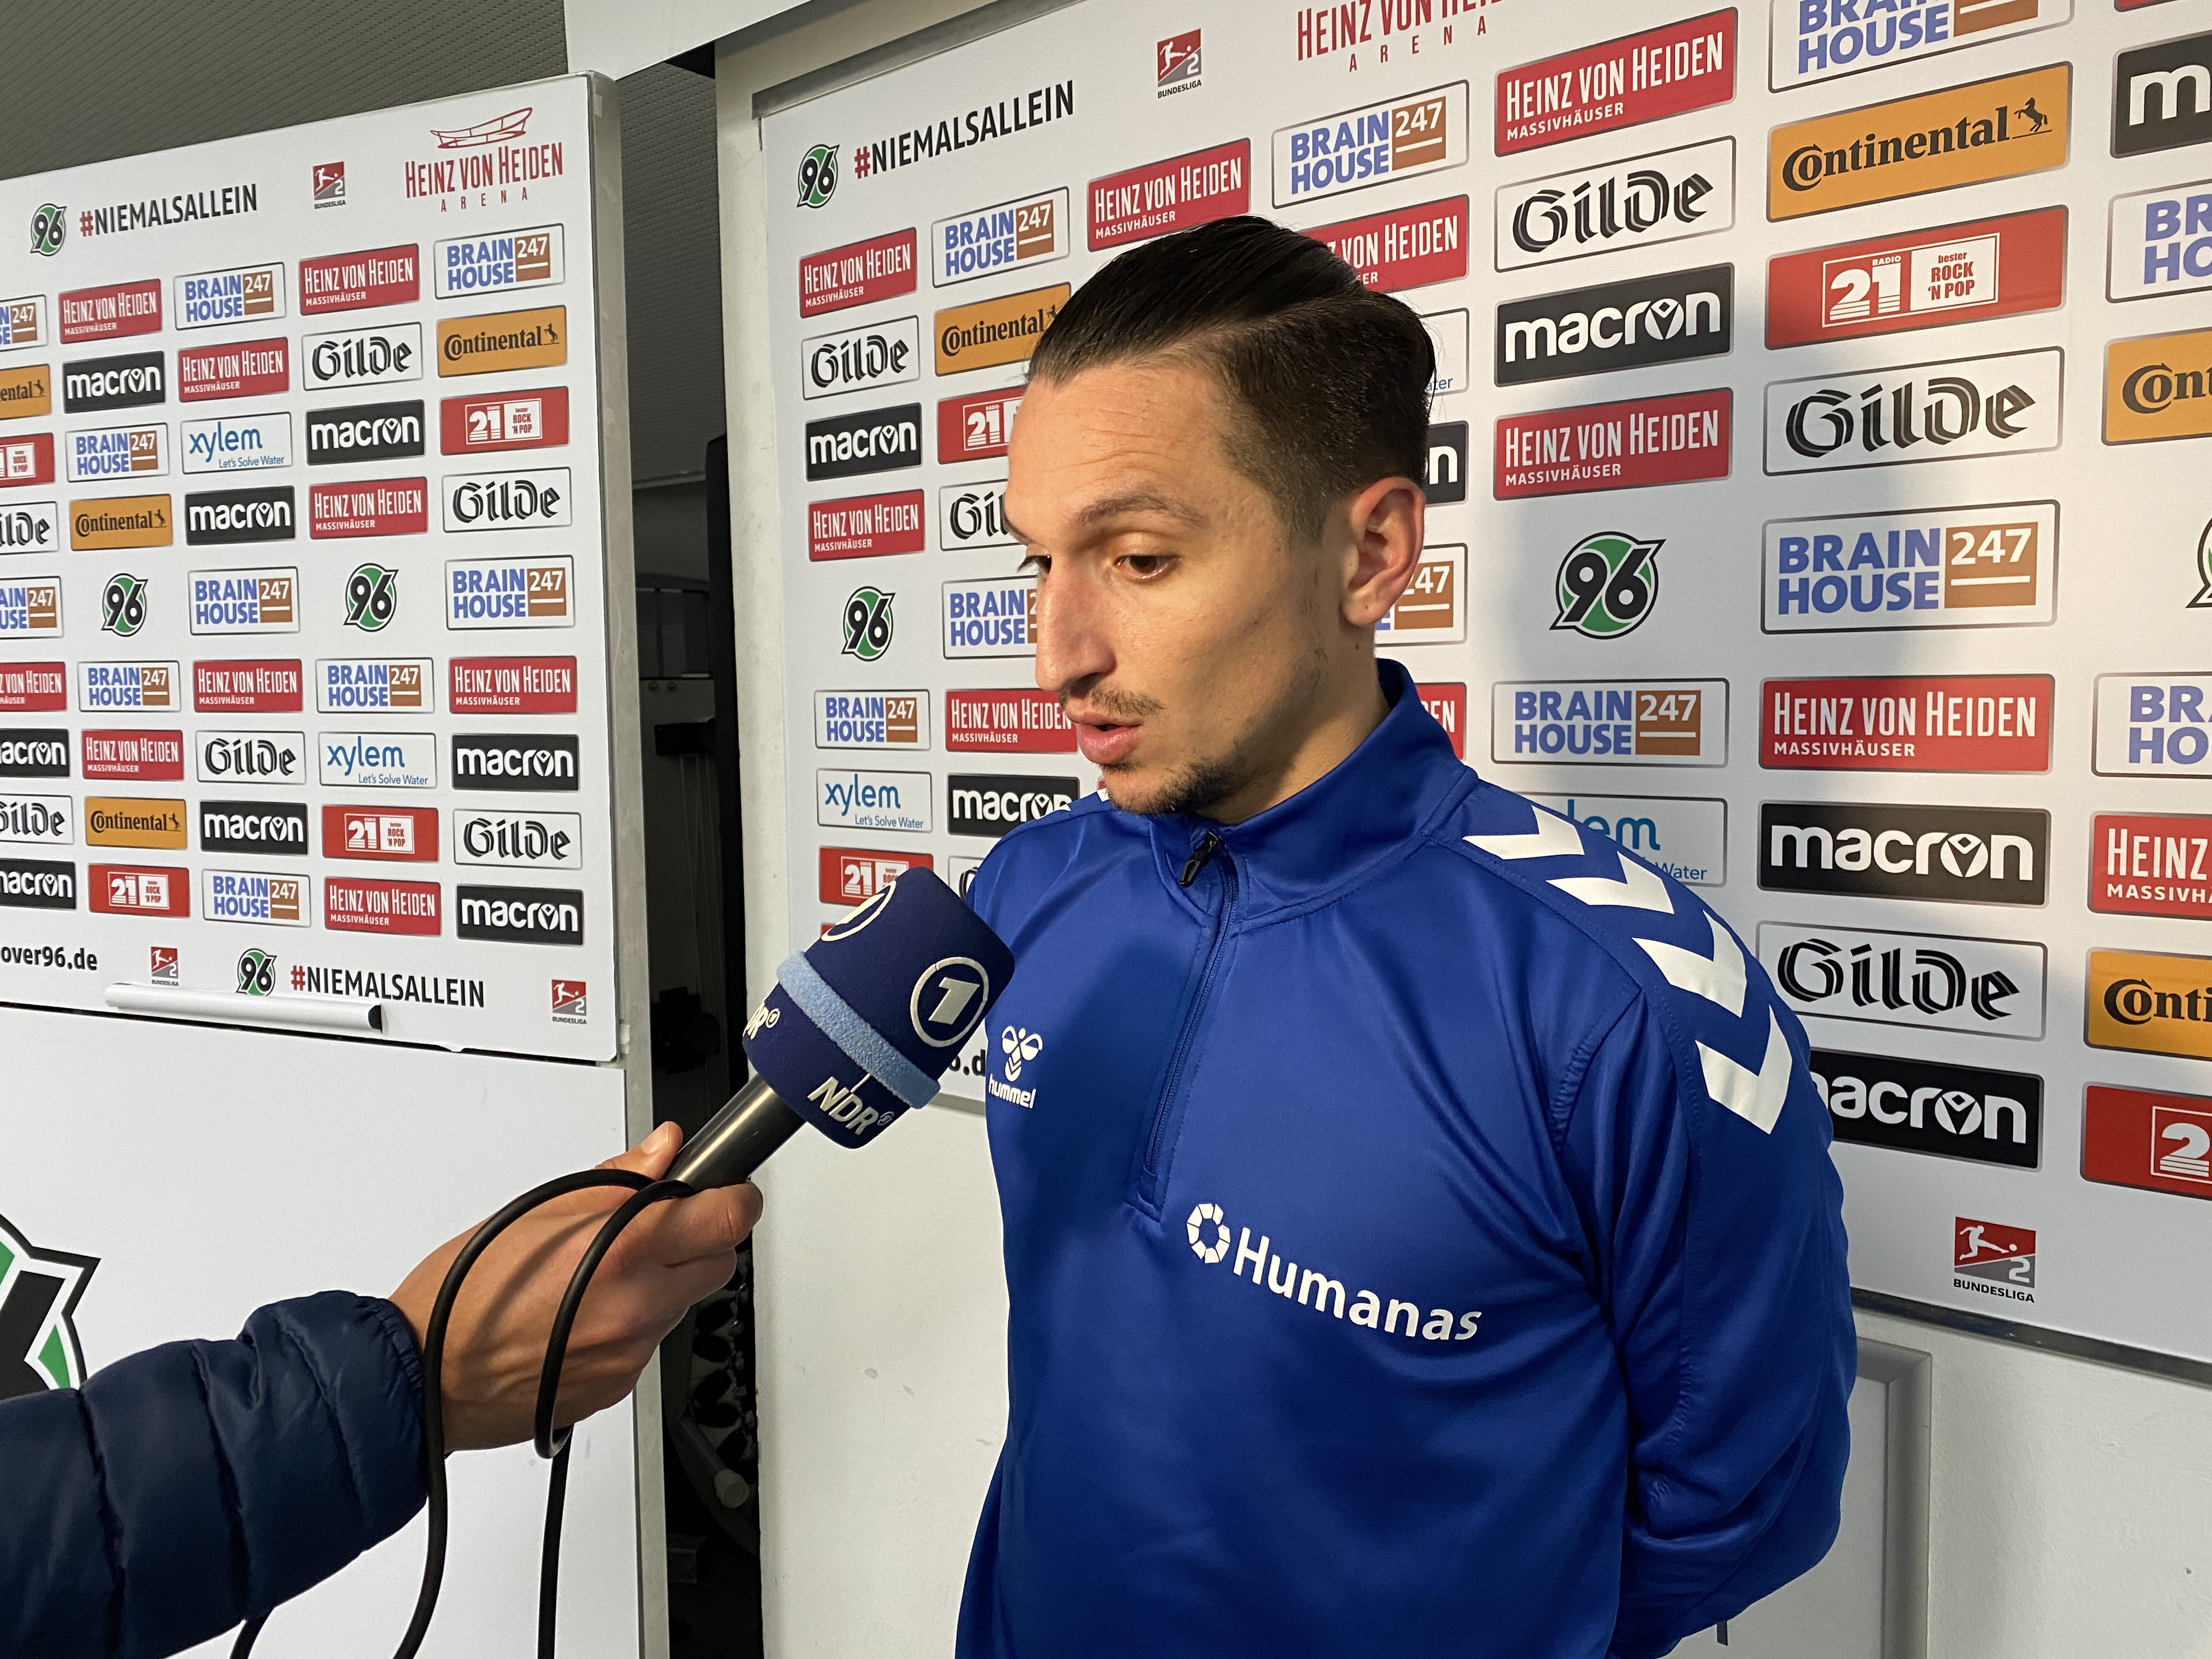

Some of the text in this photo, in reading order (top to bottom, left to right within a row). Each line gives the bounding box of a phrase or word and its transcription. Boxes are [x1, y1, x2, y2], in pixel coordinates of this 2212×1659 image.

[1298, 0, 1431, 60] HEINZ VON
[1799, 0, 1938, 35] BRA
[1349, 15, 1486, 72] ARENA
[1798, 3, 1949, 74] HOUSE
[1187, 56, 1199, 74] 2
[1158, 80, 1201, 99] BUNDESLIGA
[1507, 102, 1624, 141] MASSIVHÄUSER
[802, 80, 1073, 201] 96 #NIEMALSALLEIN
[1783, 106, 2010, 191] Continental
[405, 143, 563, 198] HEINZ VON HEIDEN
[335, 179, 344, 195] 2
[441, 187, 528, 212] ARENA
[33, 184, 257, 250] 96 #NIEMALSALLEIN
[314, 200, 346, 210] BUNDESLIGA
[1513, 170, 1713, 252] Gilde
[1341, 216, 1457, 268] VON HEIDEN
[1938, 251, 1967, 263] bester
[805, 244, 910, 295] HEINZ VON HEIDEN
[1931, 263, 1973, 283] ROCK
[1830, 264, 1901, 321] 21
[1945, 279, 1975, 298] POP
[13, 306, 34, 324] 247
[63, 292, 156, 325] HEINZ VON HEIDEN
[186, 297, 242, 323] HOUSE
[941, 308, 1043, 357] Continental
[1505, 291, 1720, 363] macron
[312, 336, 412, 381] Gilde
[444, 326, 542, 361] Continental
[183, 350, 283, 382] HEINZ VON HEIDEN
[811, 335, 909, 388] Gilde
[469, 410, 501, 441] 21
[513, 413, 531, 424] ROCK
[519, 424, 532, 433] POP
[967, 409, 1000, 447] 21
[1786, 376, 2036, 458] Gilde
[76, 433, 155, 455] BRAIN 247
[189, 421, 262, 462] xylem
[810, 422, 917, 464] macron
[77, 454, 128, 475] HOUSE
[219, 455, 284, 468] Let's Solve Water
[1505, 464, 1621, 486] MASSIVHÄUSER
[0, 512, 49, 546] lde
[75, 511, 153, 537] Continental
[189, 502, 291, 531] macron
[315, 520, 375, 531] MASSIVHÄUSER
[1779, 528, 2032, 574] BRAIN 247
[195, 579, 290, 602] BRAIN 247
[453, 569, 563, 593] BRAIN 247
[1403, 566, 1450, 595] 47
[1562, 548, 1652, 622] 96
[0, 588, 54, 607] AIN 247
[106, 583, 142, 628] 96
[351, 575, 391, 620] 96
[950, 589, 1024, 619] BRAIN
[0, 610, 26, 629] USE
[847, 599, 889, 650] 96
[5, 673, 25, 693] VON
[26, 671, 61, 693] HEIDEN
[199, 696, 254, 705] MASSIVHÄUSER
[826, 697, 915, 719] BRAIN 247
[1515, 691, 1696, 721] BRAIN 247
[1774, 691, 2036, 737] HEINZ VON HEIDEN
[827, 721, 884, 742] HOUSE
[952, 733, 1018, 743] MASSIVHÄUSER
[1515, 724, 1632, 755] HOUSE
[0, 742, 65, 766] acron
[86, 738, 178, 763] HEINZ VON HEIDEN
[205, 738, 296, 776] Gilde
[327, 736, 405, 776] xylem
[457, 749, 573, 777] macron
[1774, 741, 1915, 757] MASSIVHÄUSER
[359, 774, 428, 786] Let's Solve Water
[825, 774, 901, 816] xylem
[91, 811, 167, 832] Continental
[204, 814, 303, 843] macron
[348, 821, 377, 849] 21
[388, 828, 404, 838] ROCK
[855, 815, 923, 828] Let's Solve Water
[394, 839, 405, 847] POP
[464, 818, 571, 860] Gilde
[1771, 825, 2034, 881] macron
[2108, 828, 2208, 880] HEINZ
[111, 881, 136, 904] 21
[213, 876, 296, 900] BRAIN 247
[845, 864, 872, 895] 21
[2107, 883, 2212, 904] MASSIVH
[214, 897, 268, 918] HOUSE
[330, 885, 435, 917] HEINZ VON HEIDEN
[461, 899, 578, 932] macron
[331, 915, 389, 926] MASSIVHÄUSER
[169, 965, 177, 977] 2
[240, 958, 272, 991] 96
[291, 965, 484, 1007] #NIEMALSALLEIN
[1778, 938, 2019, 1020] Gilde
[575, 1000, 584, 1013] 2
[929, 977, 980, 1025] 1
[552, 1017, 587, 1025] BUNDESLIGA
[743, 1001, 769, 1040] DR
[808, 1076, 879, 1136] NDR
[989, 1074, 1036, 1109] hummel
[1233, 1227, 1481, 1340] Humanas
[2008, 1257, 2030, 1283] 2
[1954, 1279, 2034, 1302] BUNDESLIGA
